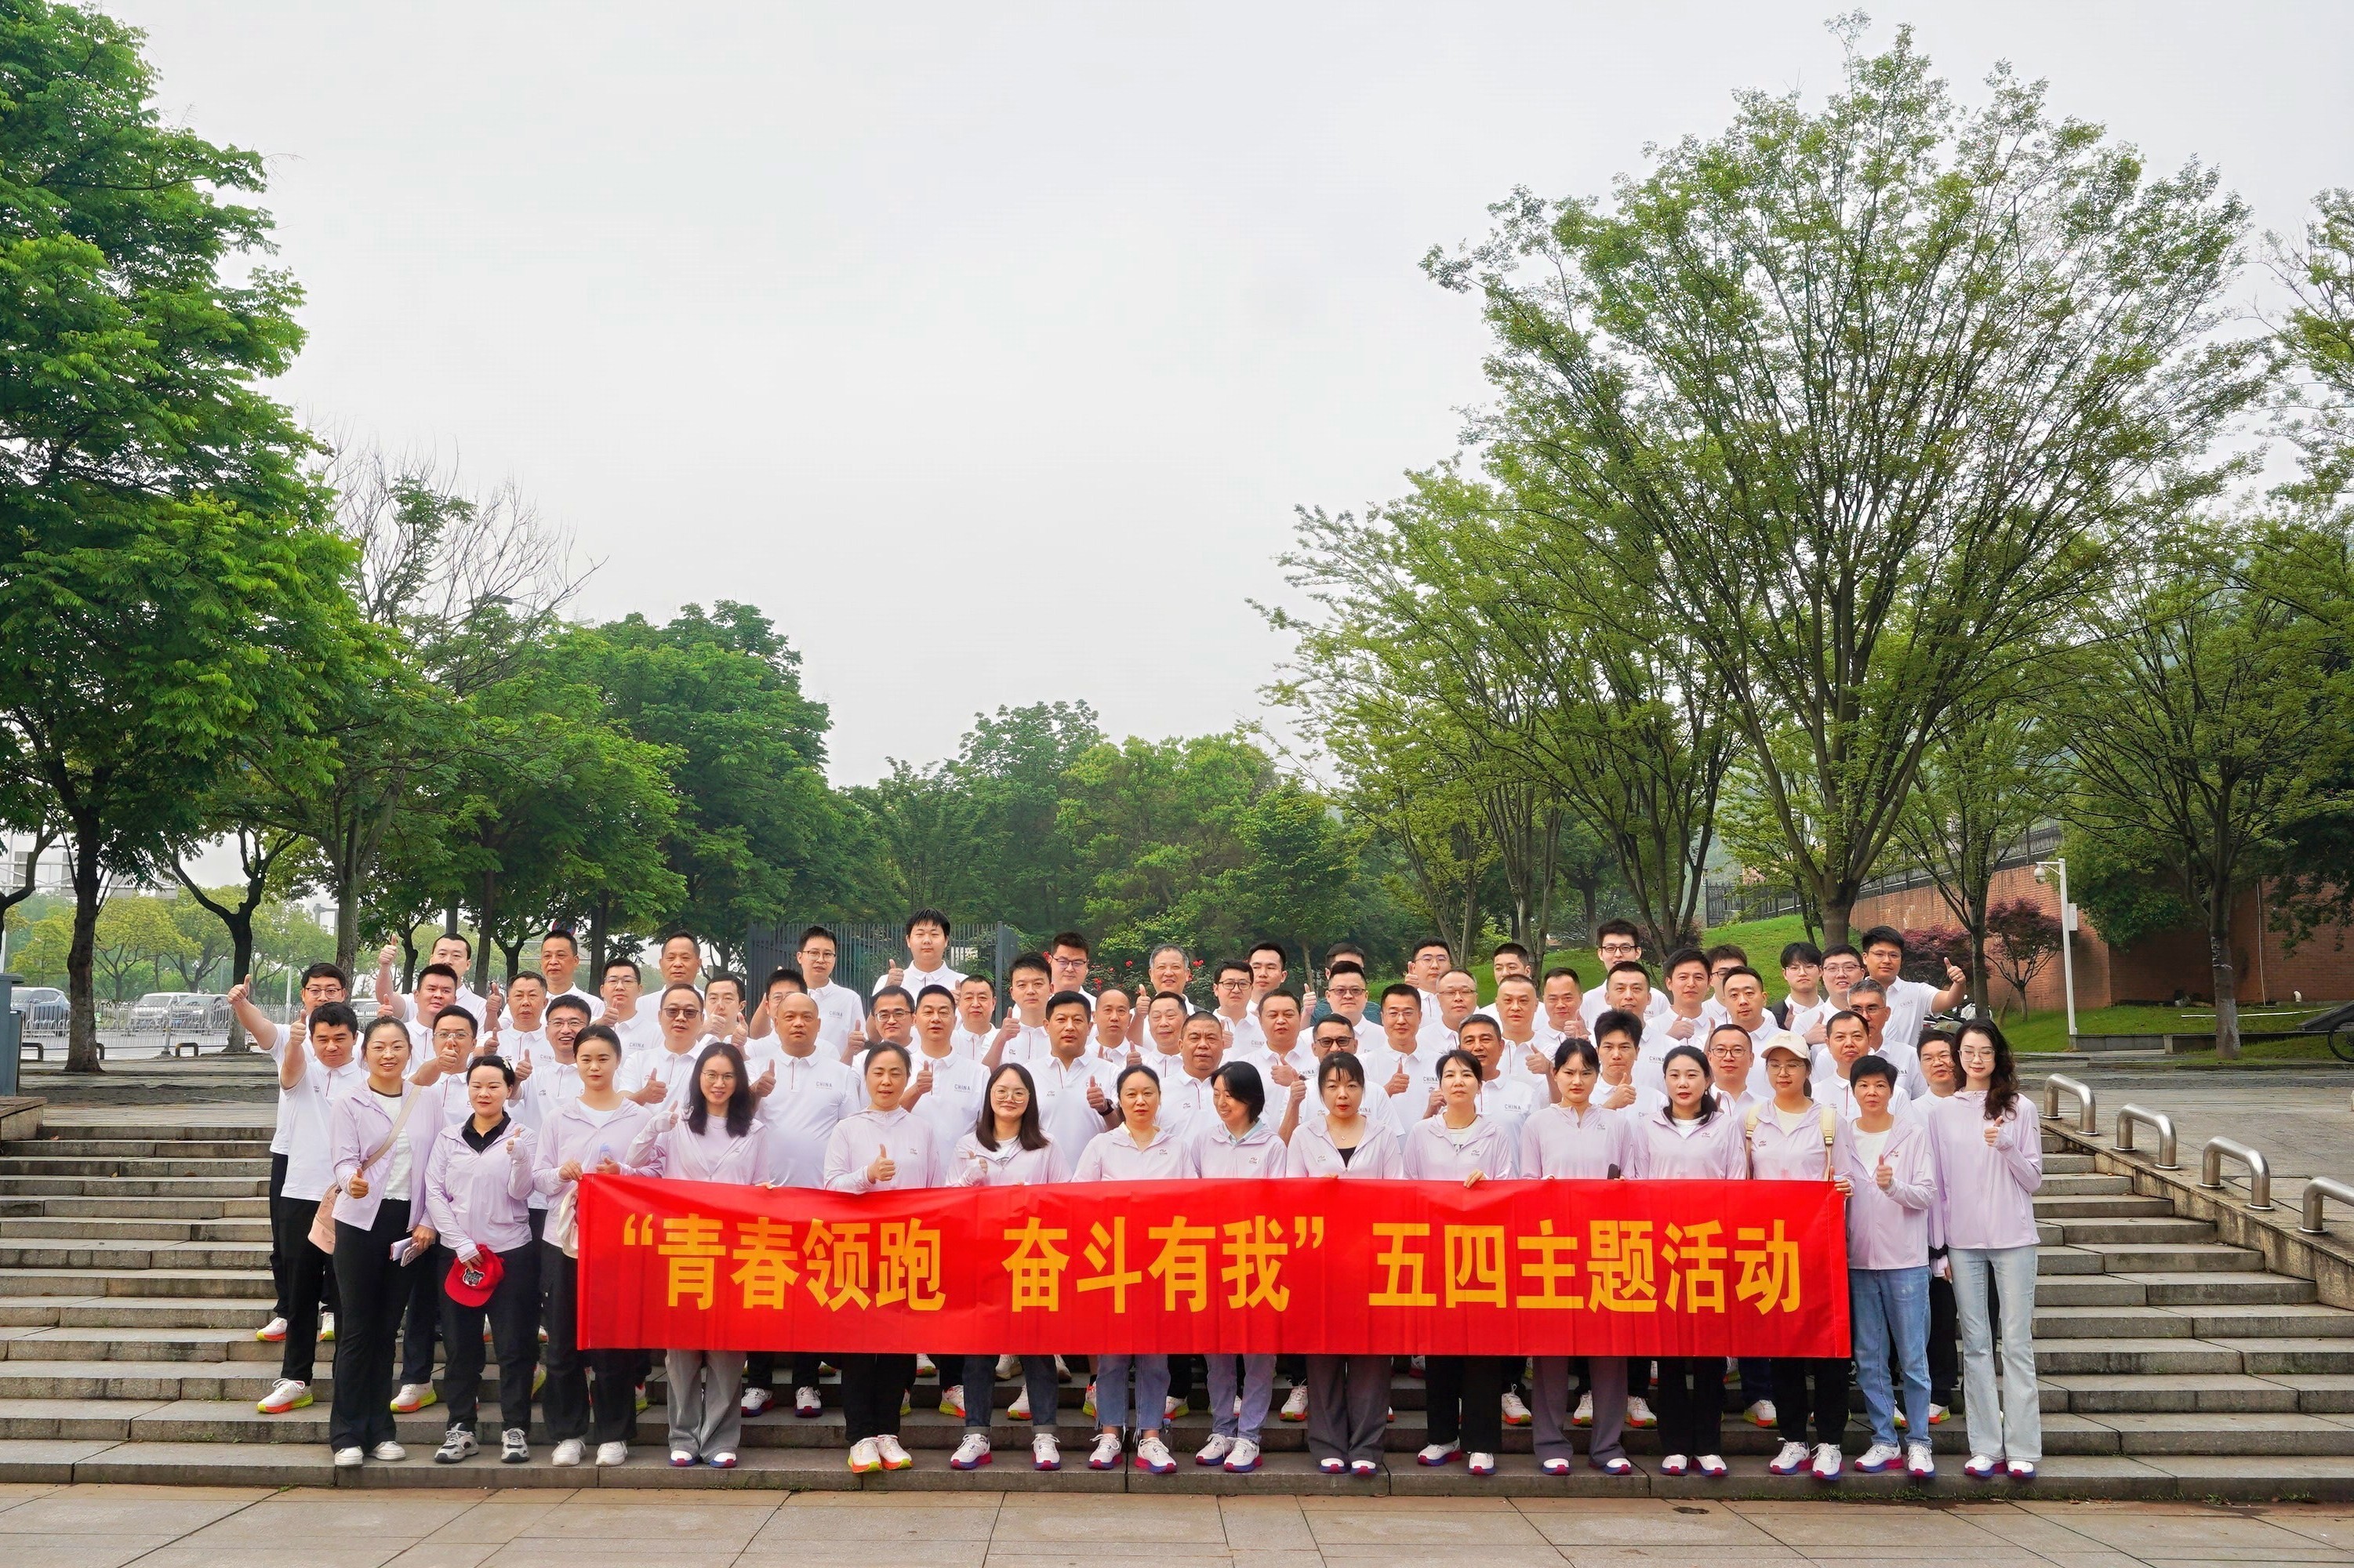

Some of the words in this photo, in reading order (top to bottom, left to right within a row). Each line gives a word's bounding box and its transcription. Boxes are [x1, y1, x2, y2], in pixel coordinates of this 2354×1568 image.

[623, 1213, 946, 1312] “青春领跑
[1001, 1215, 1324, 1314] 奋斗有我”
[1368, 1219, 1800, 1316] 五四主题活动
